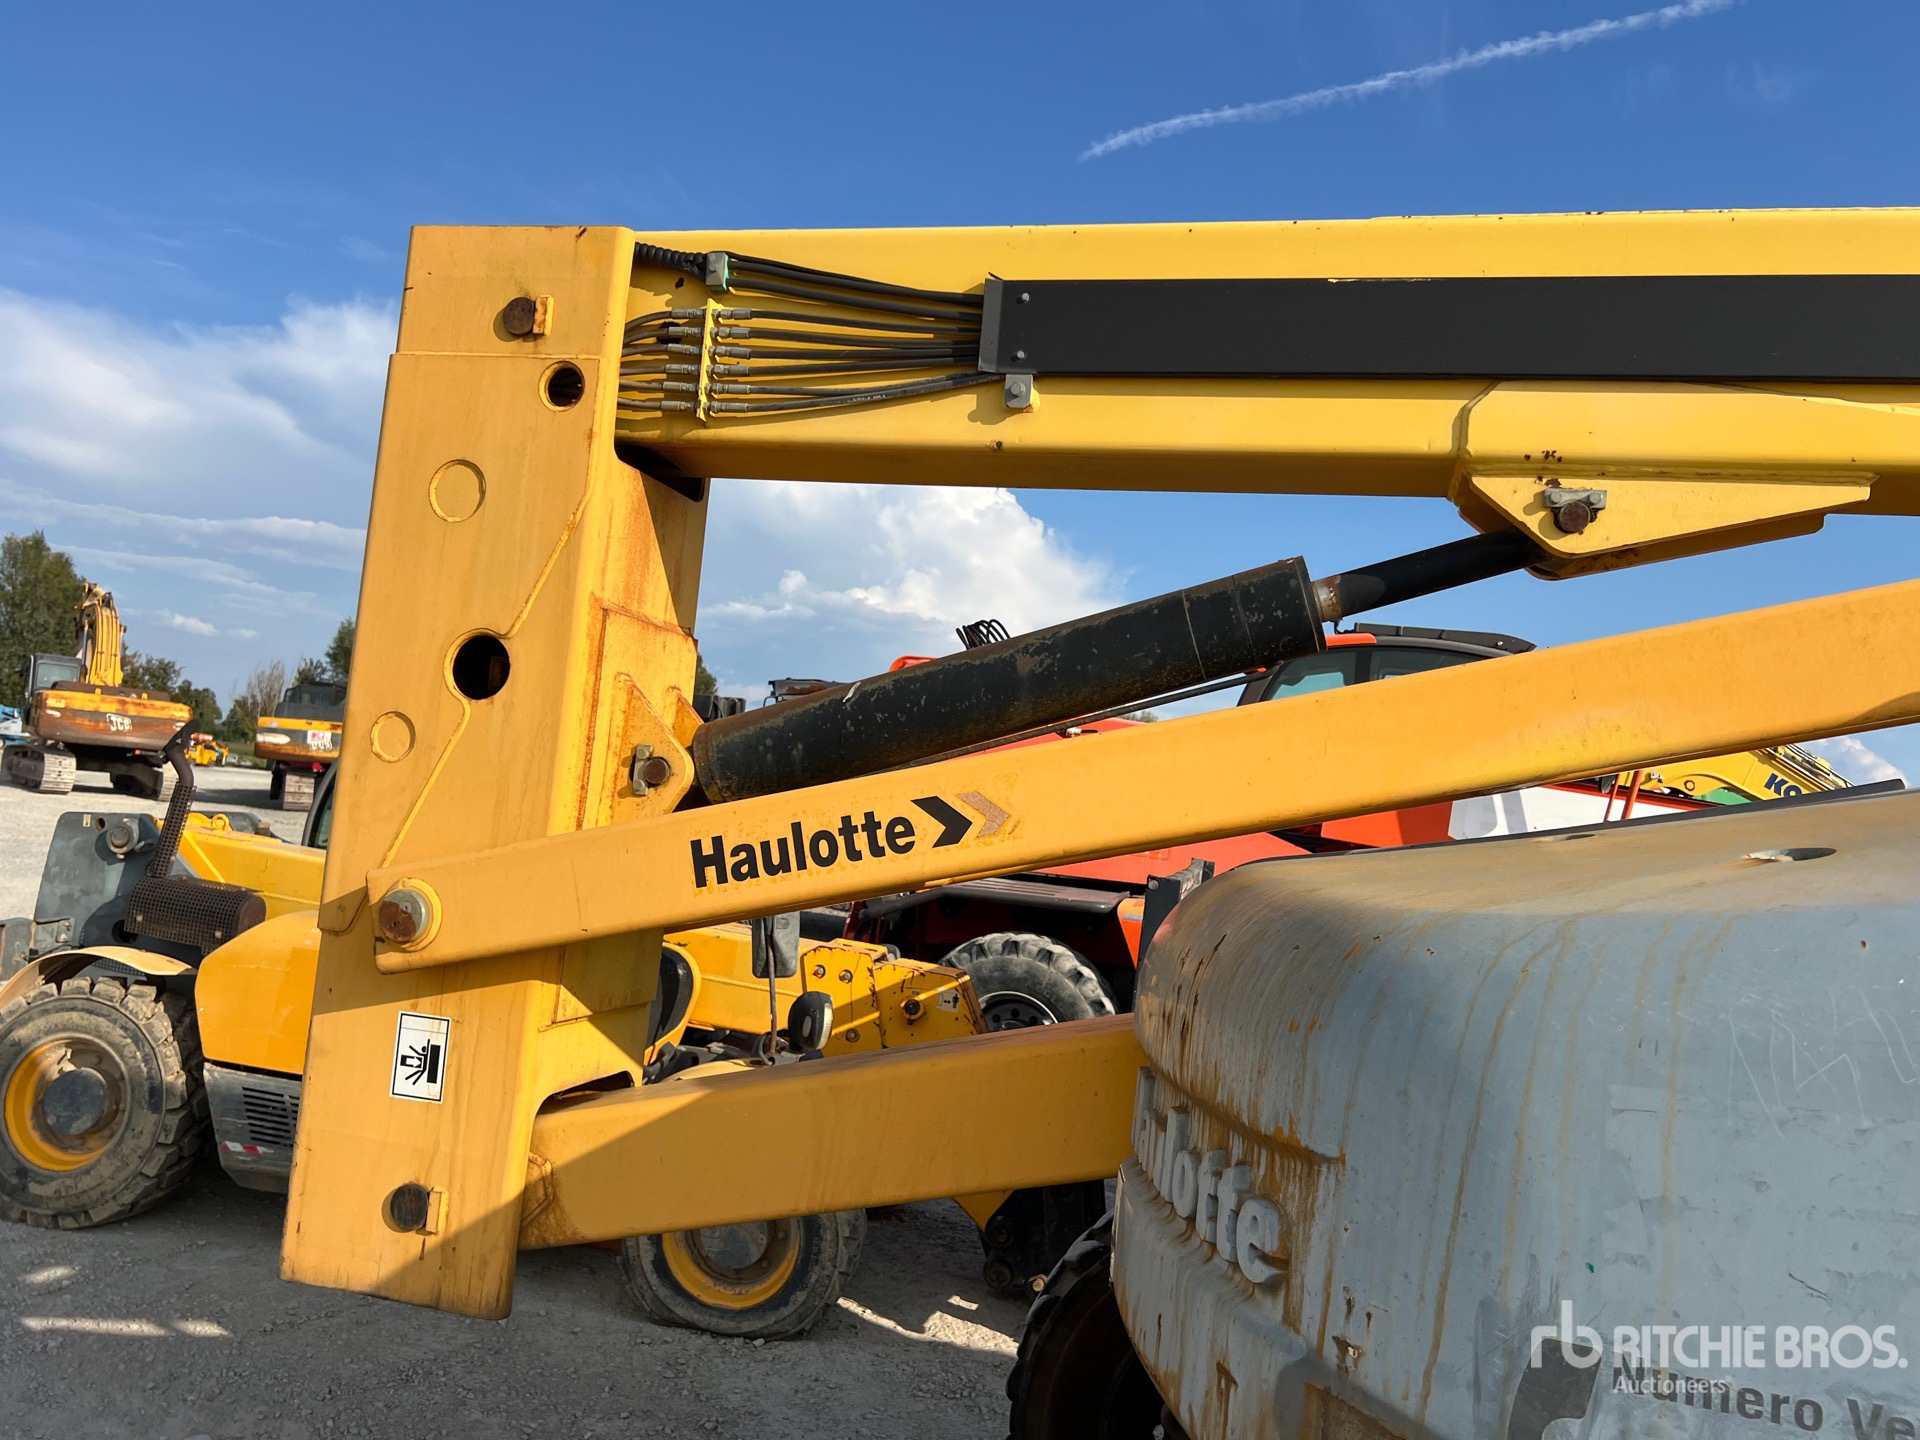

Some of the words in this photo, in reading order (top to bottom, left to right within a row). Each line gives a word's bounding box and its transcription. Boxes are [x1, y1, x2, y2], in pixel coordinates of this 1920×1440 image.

[110, 714, 131, 732] JCB
[690, 811, 916, 888] Haulotte
[1612, 1351, 1824, 1432] Numero
